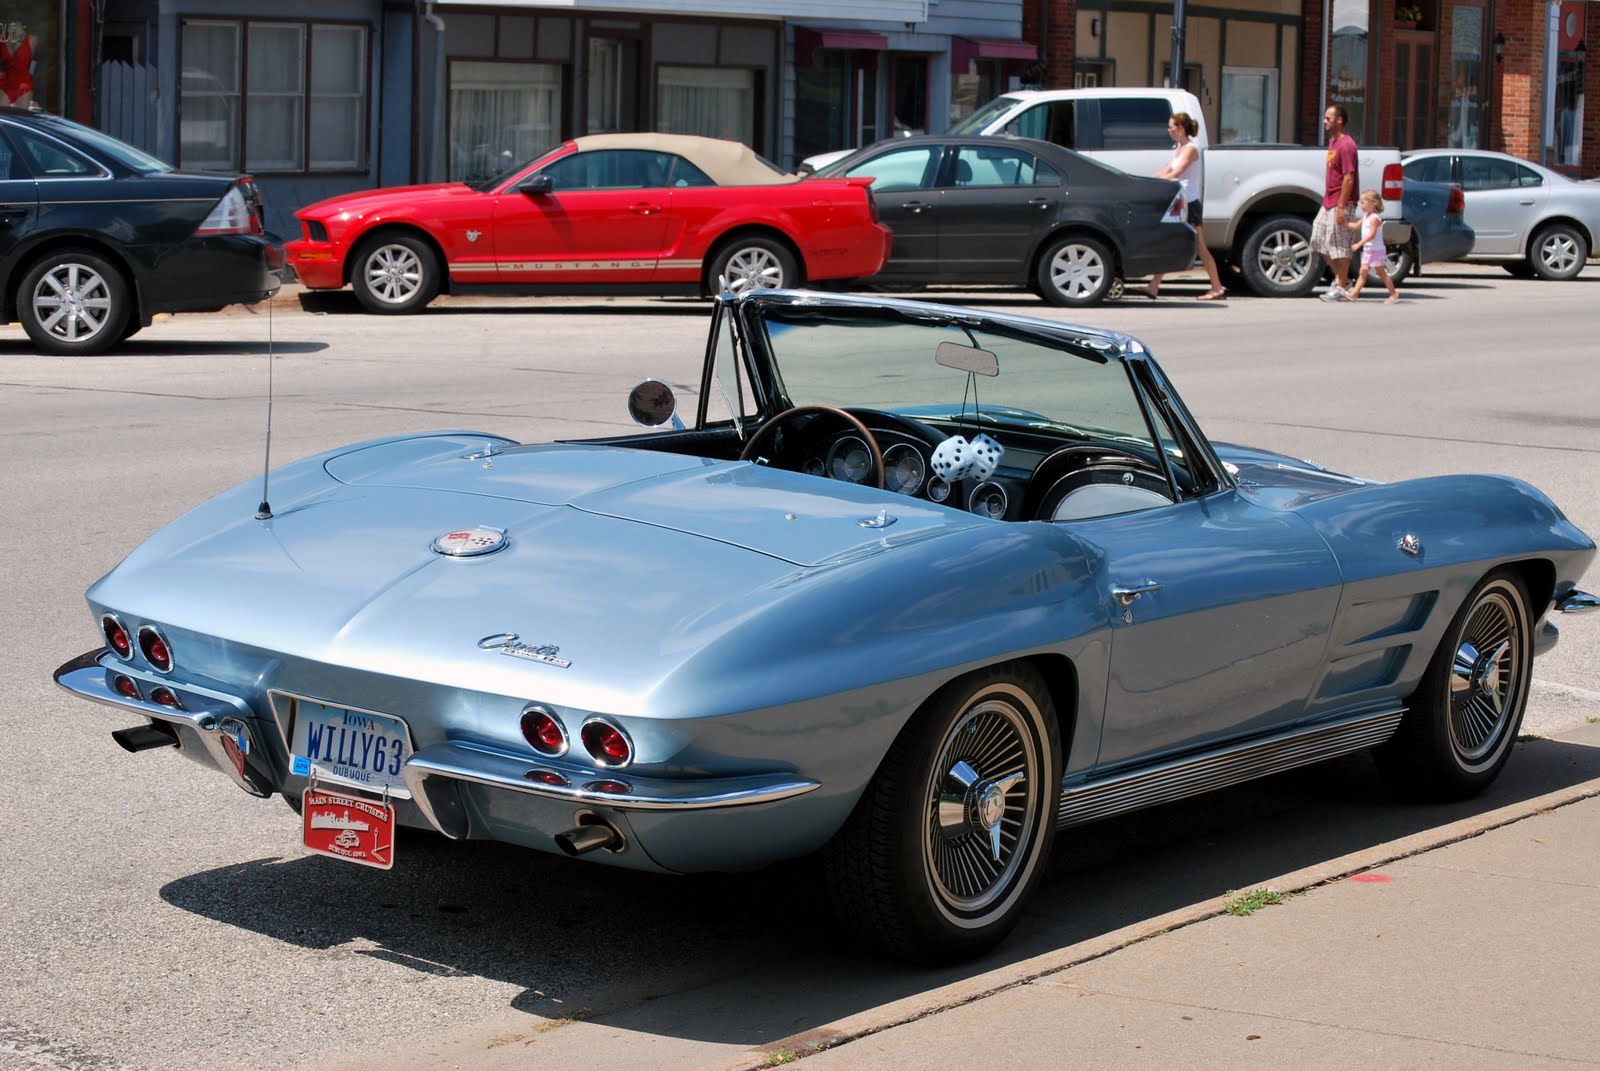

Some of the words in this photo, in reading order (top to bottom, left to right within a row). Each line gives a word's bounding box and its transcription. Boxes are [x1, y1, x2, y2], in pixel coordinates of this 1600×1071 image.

[306, 721, 403, 776] WILLY63
[295, 762, 309, 772] APR
[332, 765, 371, 783] DUBUQUE
[309, 796, 327, 806] MAIN
[328, 796, 355, 808] STREET
[355, 801, 389, 822] CRUISERS
